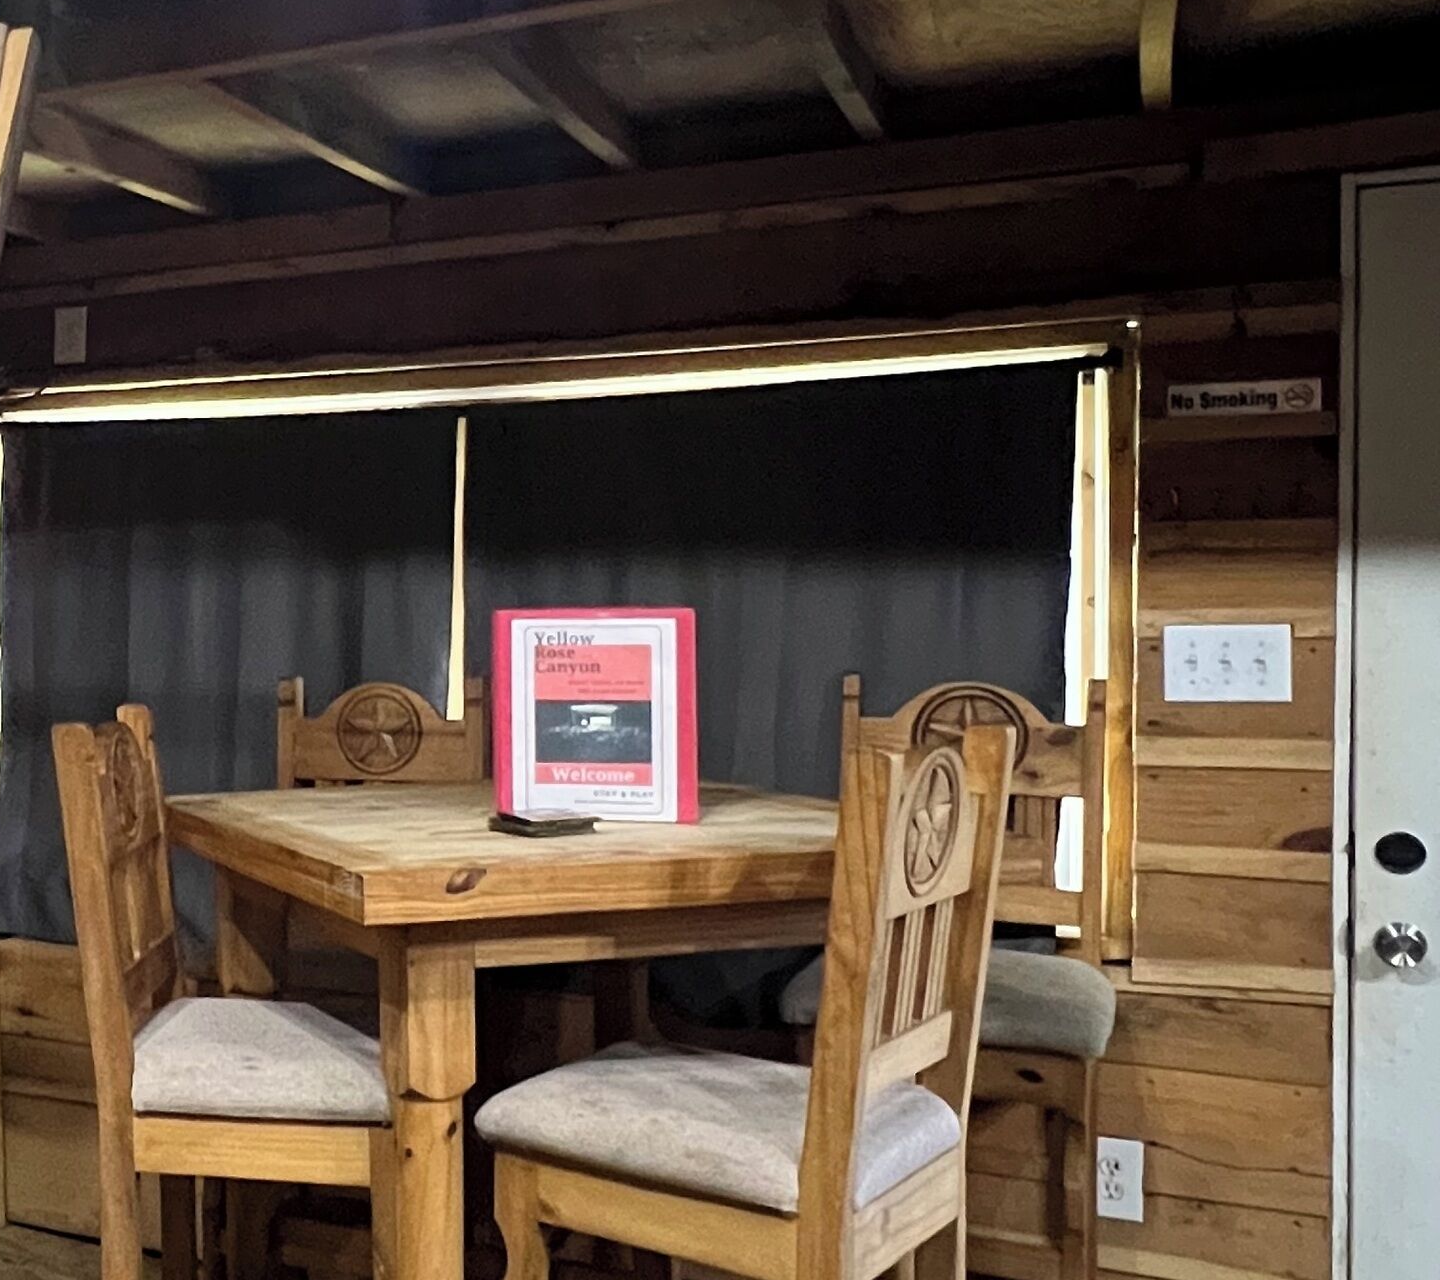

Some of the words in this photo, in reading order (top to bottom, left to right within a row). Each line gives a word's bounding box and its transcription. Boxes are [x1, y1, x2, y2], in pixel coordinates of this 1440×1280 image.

[1170, 393, 1194, 410] No
[1200, 389, 1278, 411] Smoking
[534, 631, 595, 646] Yellow
[534, 645, 576, 659] Rose
[534, 661, 602, 675] Canyon
[551, 766, 636, 783] Welcome
